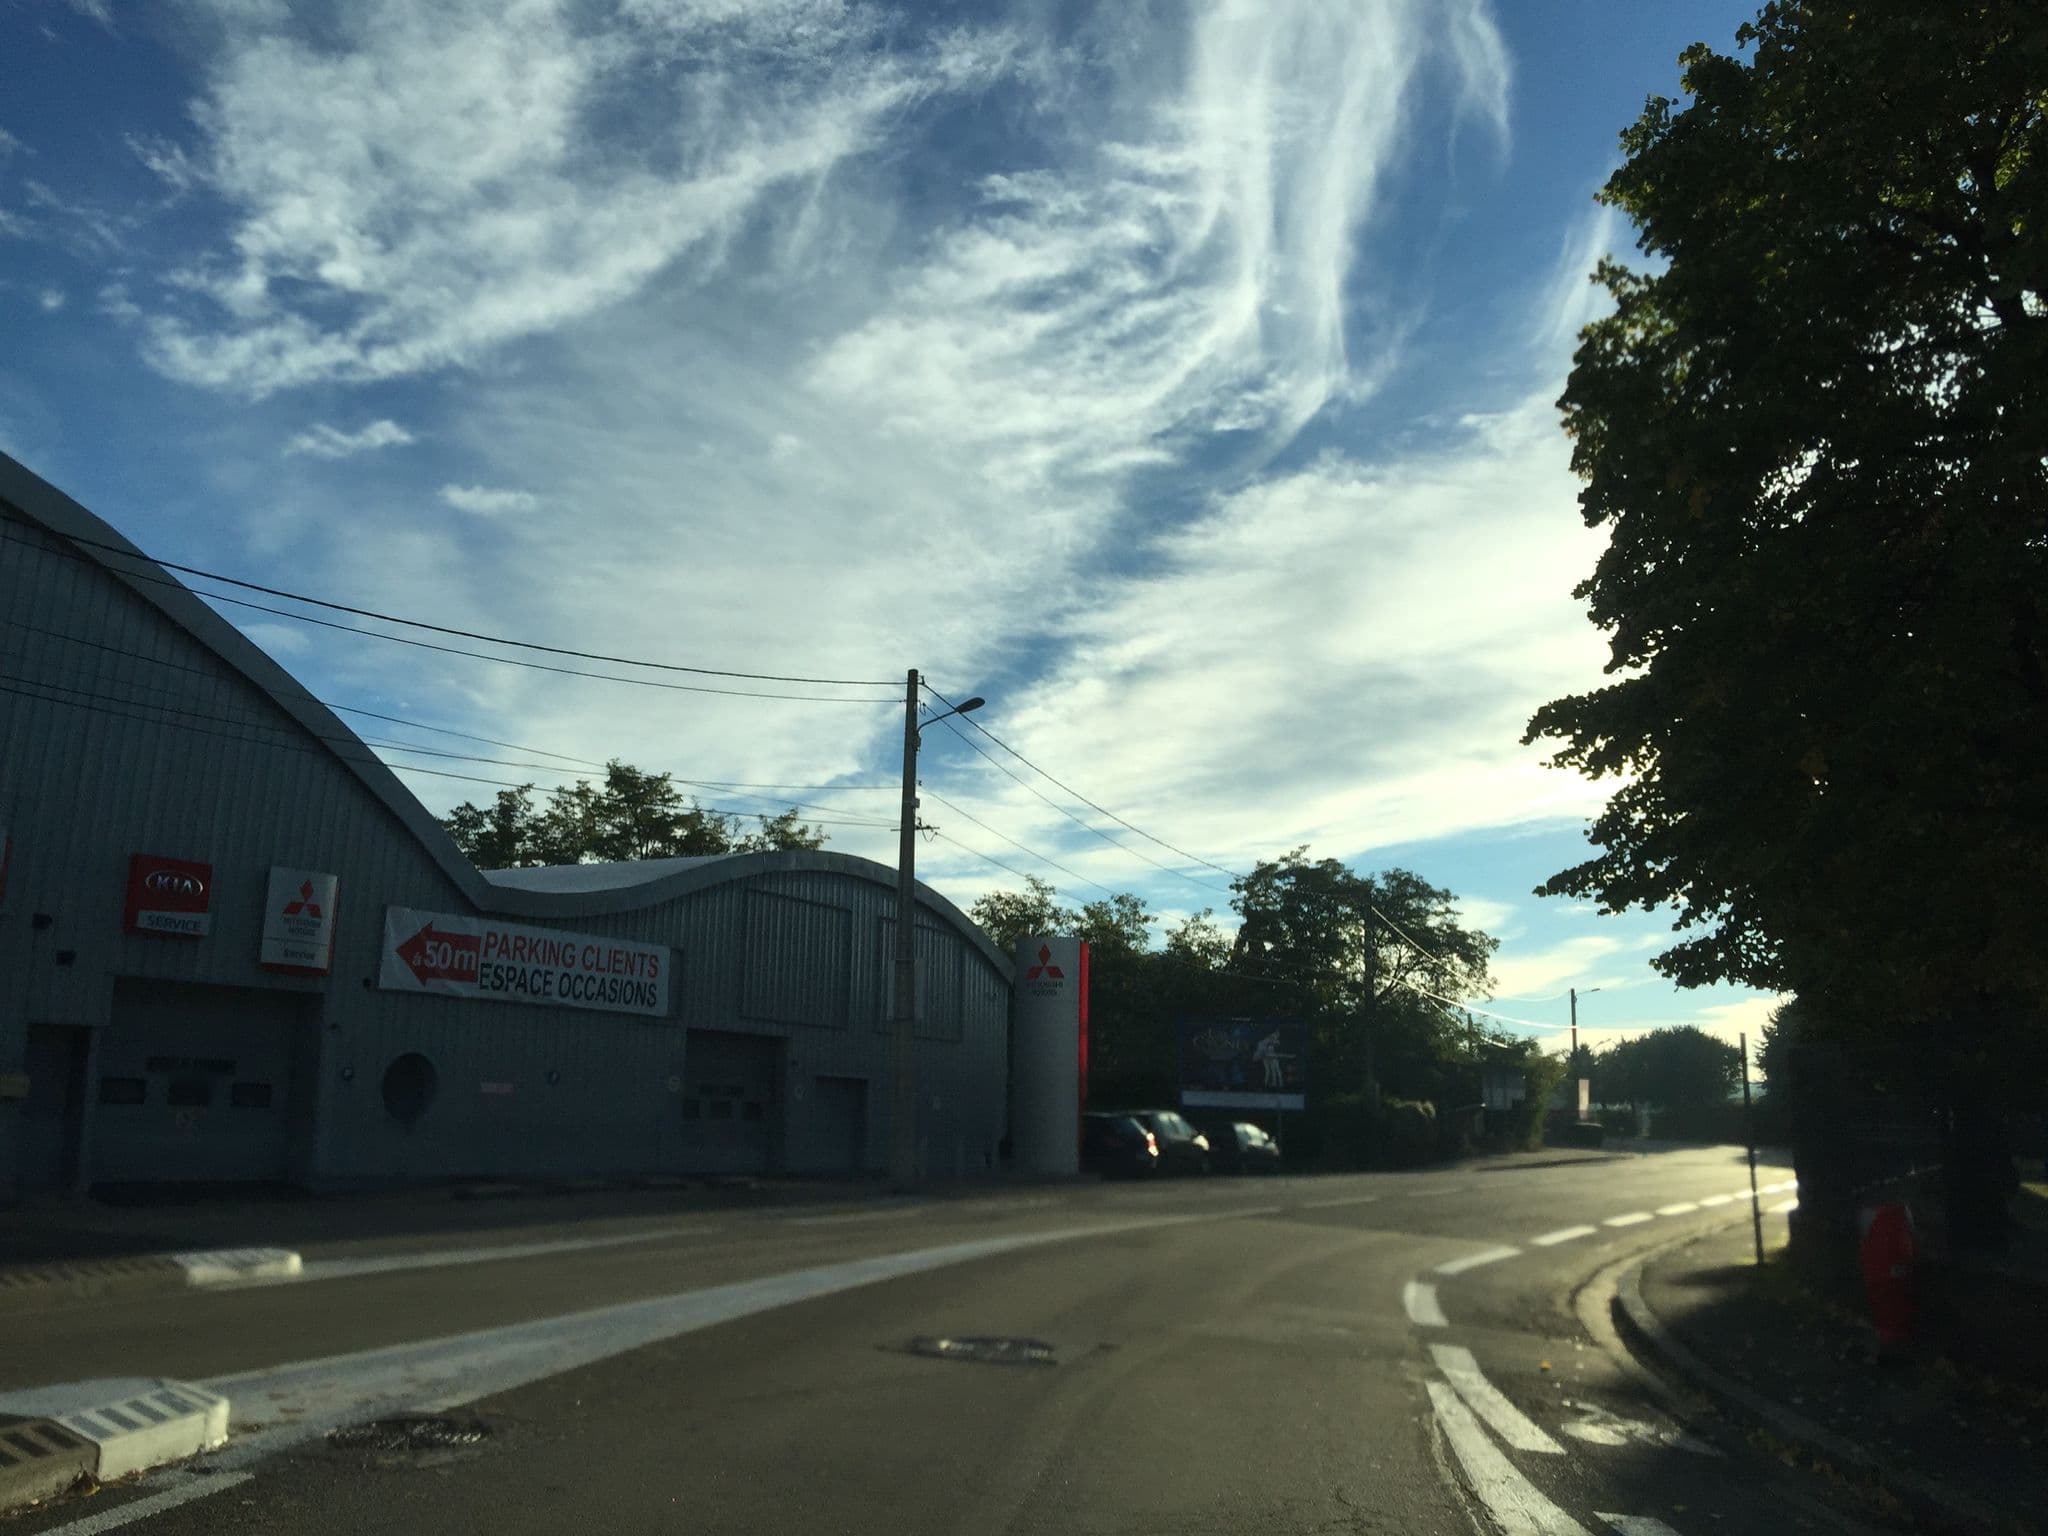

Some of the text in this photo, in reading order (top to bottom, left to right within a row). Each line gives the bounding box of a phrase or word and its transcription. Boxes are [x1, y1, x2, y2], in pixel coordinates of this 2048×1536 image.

[147, 915, 201, 932] SERVICE
[424, 940, 477, 971] 50m
[483, 931, 659, 979] PARKING CLIENTS
[479, 962, 657, 1009] ESPACE OCCASIONS
